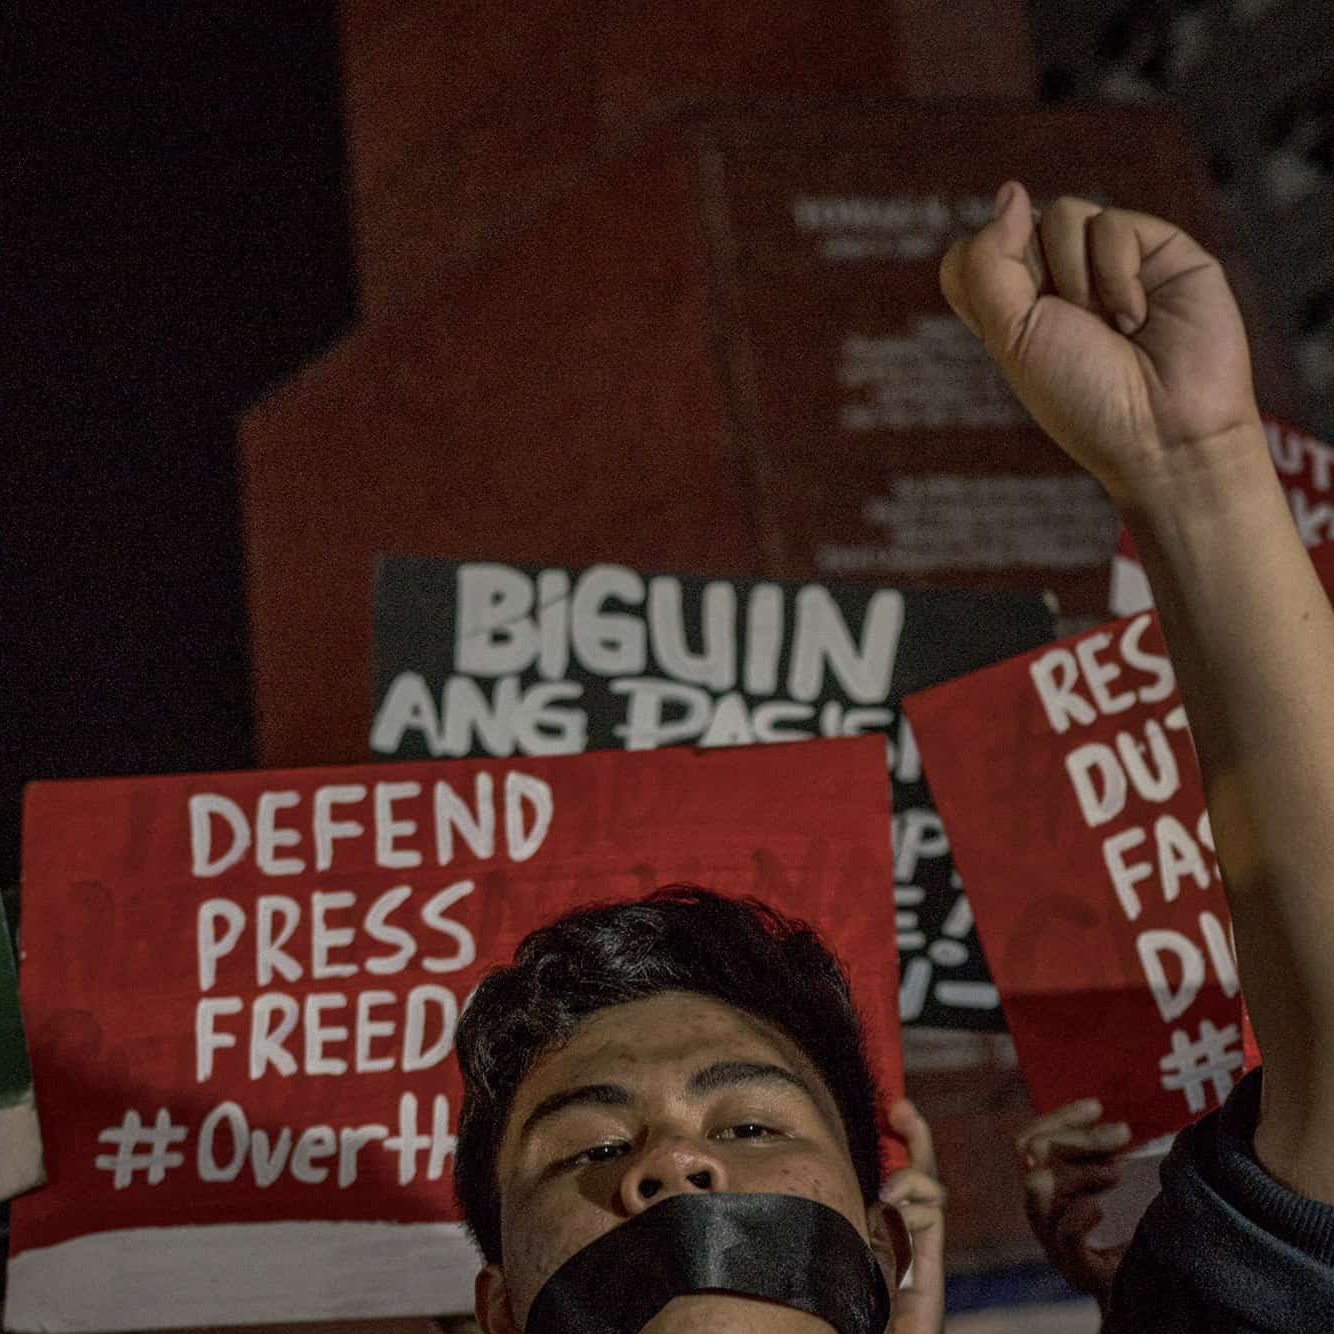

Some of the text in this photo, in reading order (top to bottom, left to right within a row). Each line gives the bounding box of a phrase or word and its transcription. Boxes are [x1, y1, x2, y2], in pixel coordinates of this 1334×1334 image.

[454, 562, 905, 703] BIGUIN
[1029, 614, 1177, 735] RES
[369, 670, 589, 757] ANG
[189, 770, 554, 877] DEFEND
[197, 878, 477, 992] PRESS
[195, 982, 479, 1083] FREED
